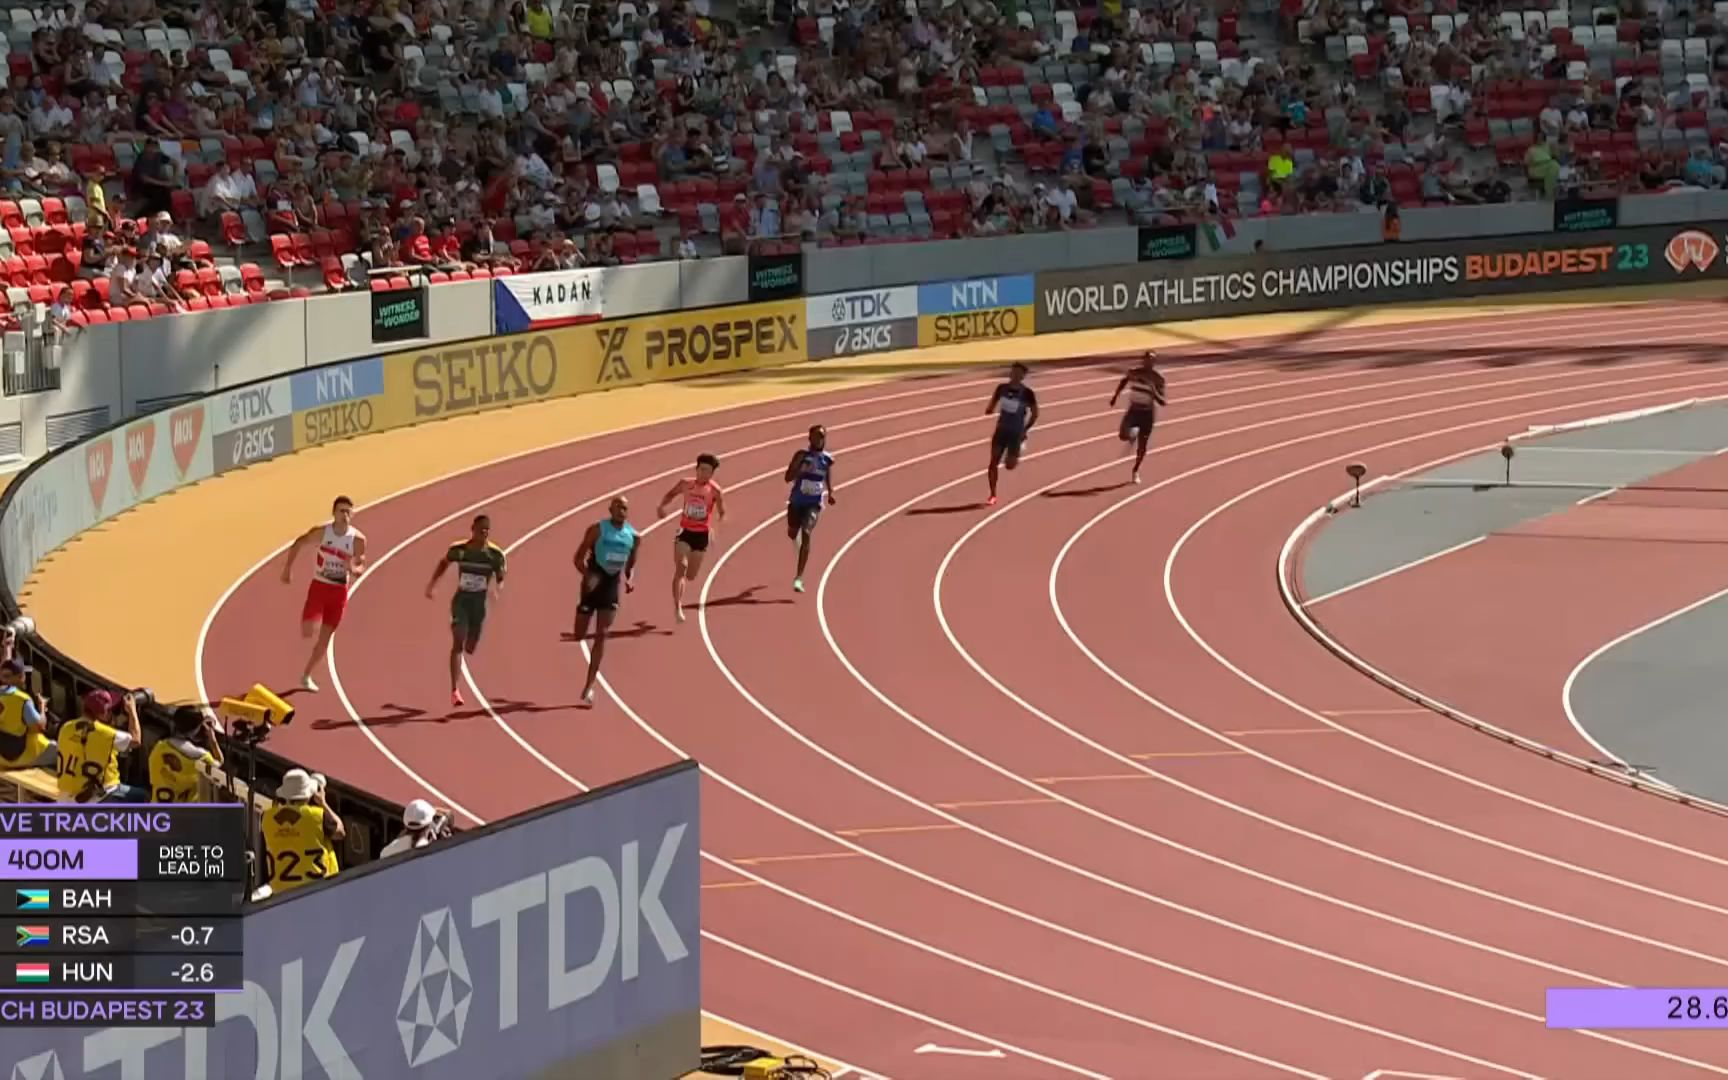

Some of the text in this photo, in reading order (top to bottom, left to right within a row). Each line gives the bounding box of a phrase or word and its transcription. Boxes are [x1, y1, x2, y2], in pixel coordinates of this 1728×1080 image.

[951, 280, 998, 308] NTN
[1045, 244, 1649, 316] WORLD ATHLETICS CHAMPIONSHIPS BUDAPEST 23
[846, 292, 892, 320] TDK
[934, 308, 1019, 343] SEIKO
[646, 314, 799, 370] PROSPEX
[316, 365, 354, 402] NTN
[412, 335, 557, 417] SEIKO
[237, 385, 274, 422] TDK
[305, 399, 374, 444] SEIKO
[471, 822, 689, 1032] TDK
